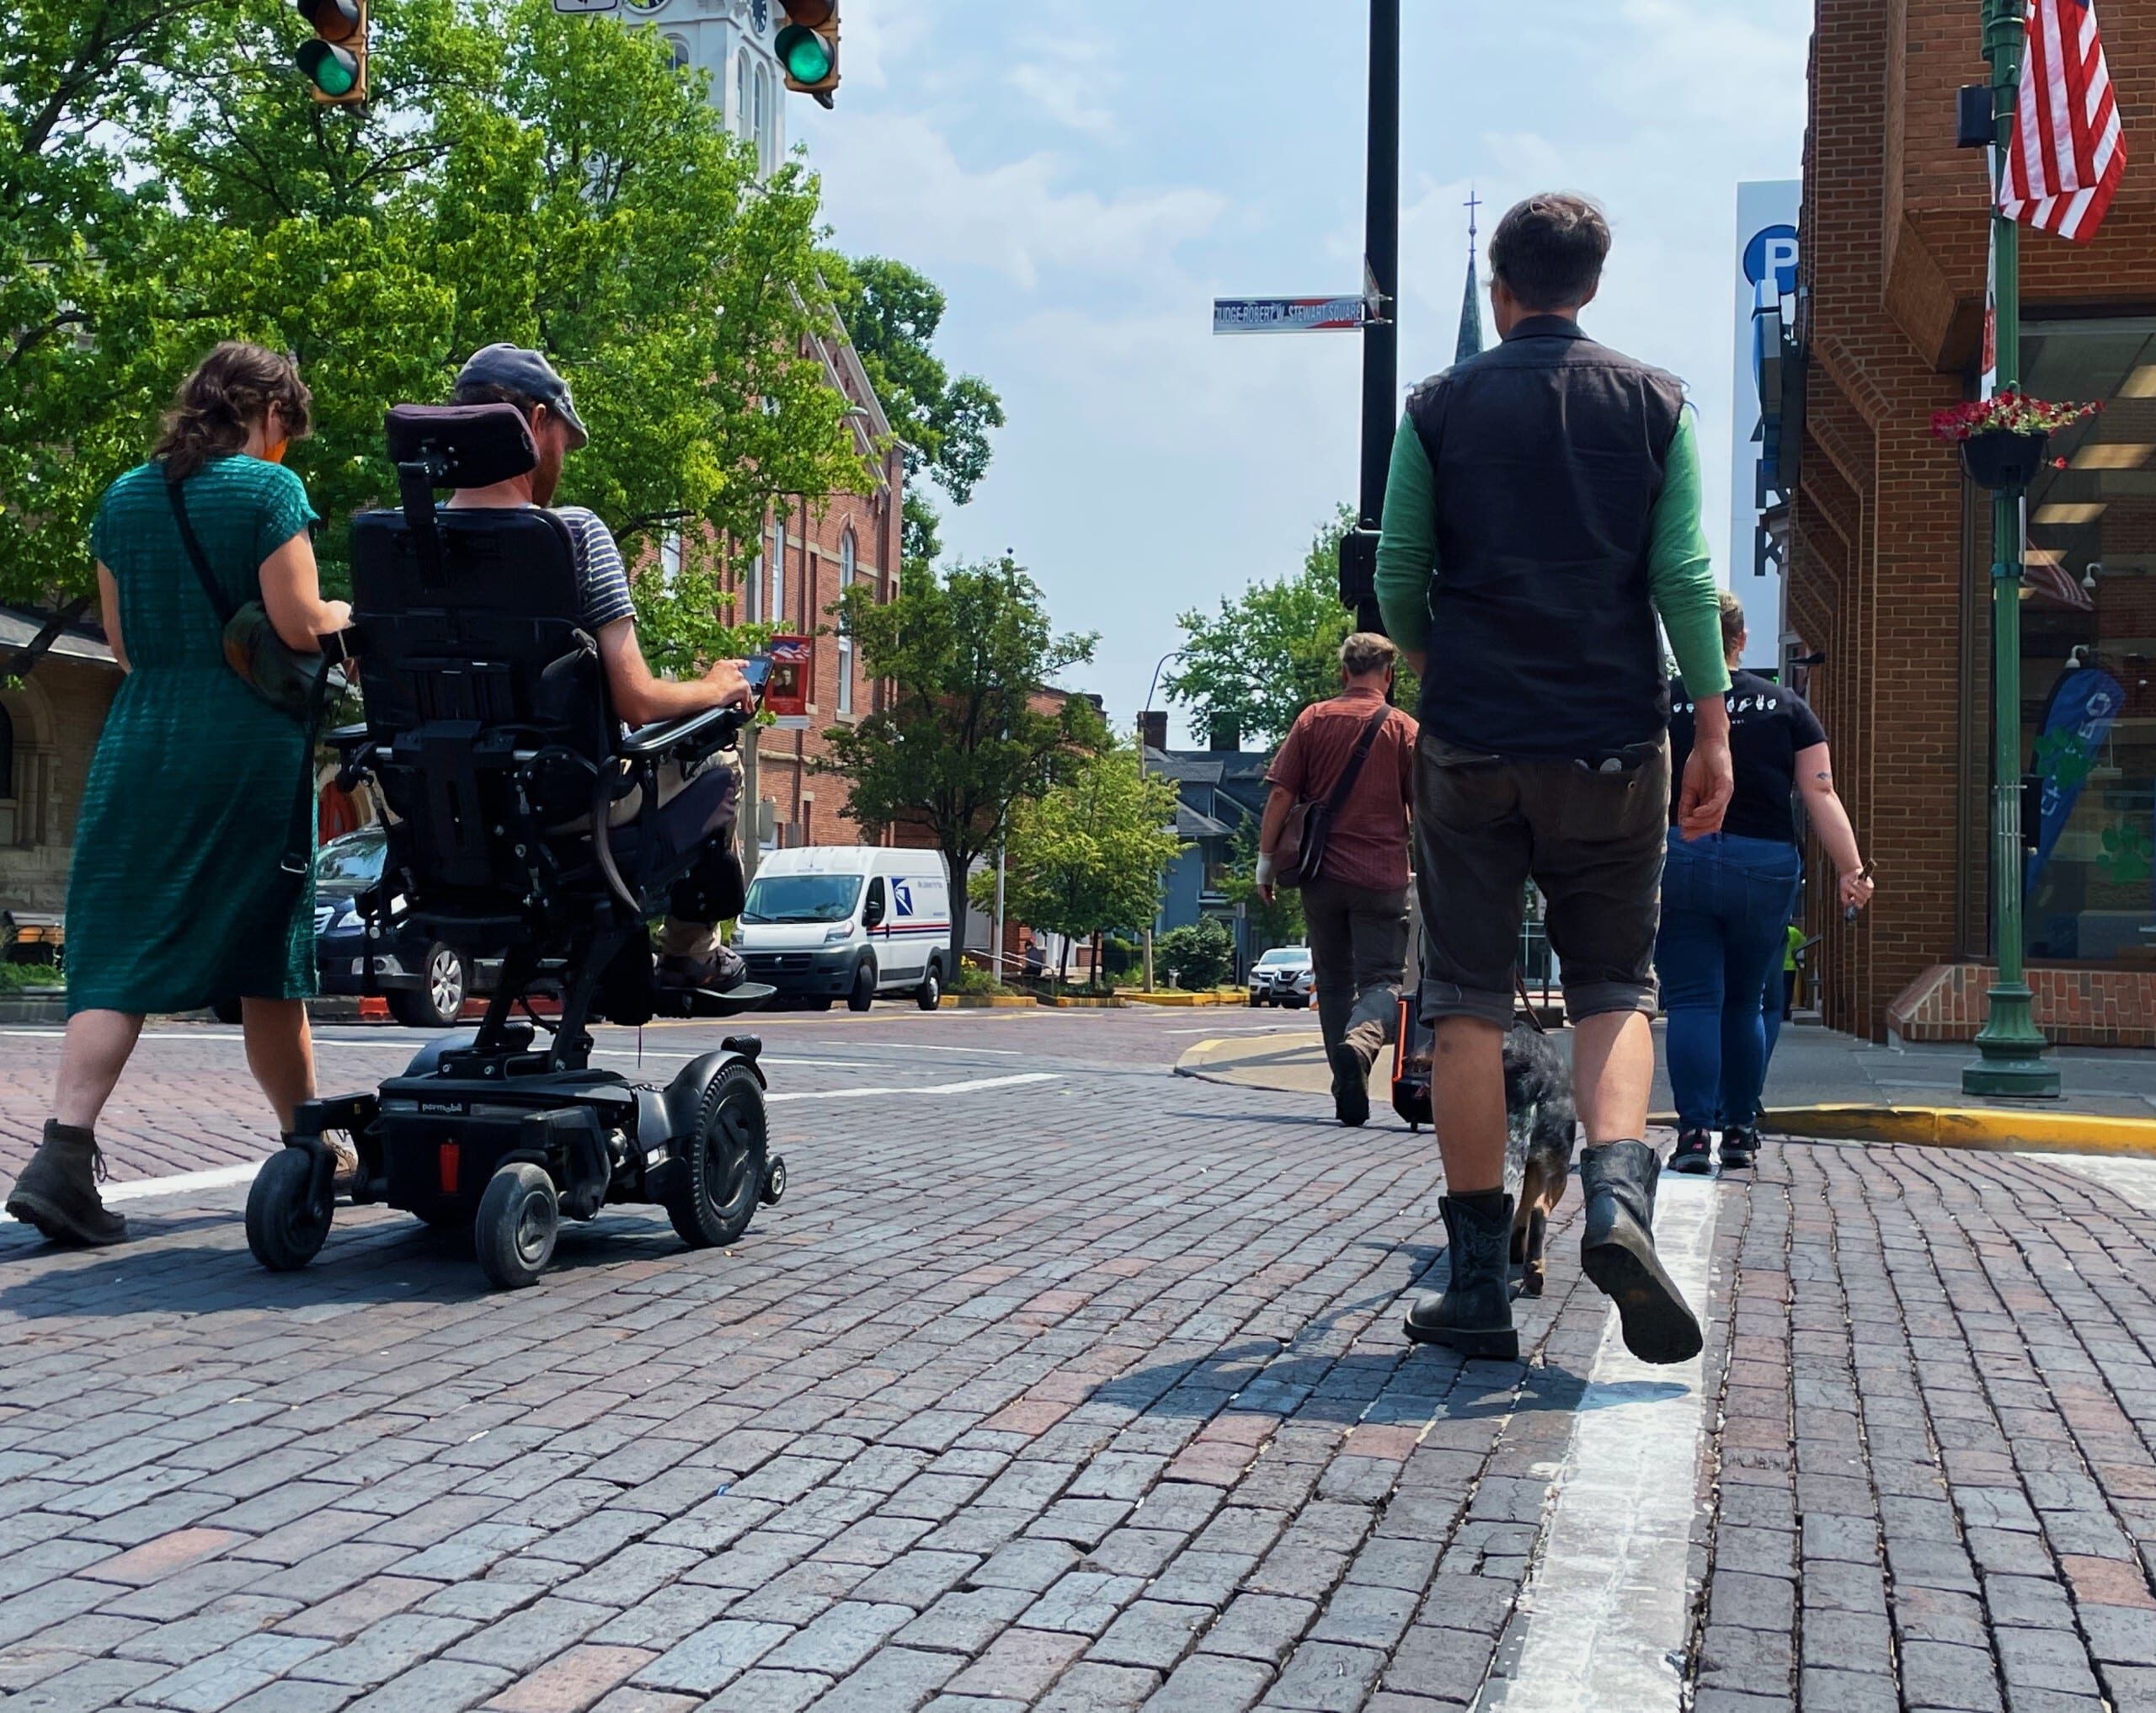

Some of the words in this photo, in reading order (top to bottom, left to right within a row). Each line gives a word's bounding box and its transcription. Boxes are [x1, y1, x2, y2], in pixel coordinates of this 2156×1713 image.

[1765, 238, 1799, 280] P
[1215, 307, 1241, 323] JUDGE
[1242, 306, 1275, 323] ROBERT
[1289, 304, 1326, 322] STEWART
[1328, 303, 1361, 322] SQUARE
